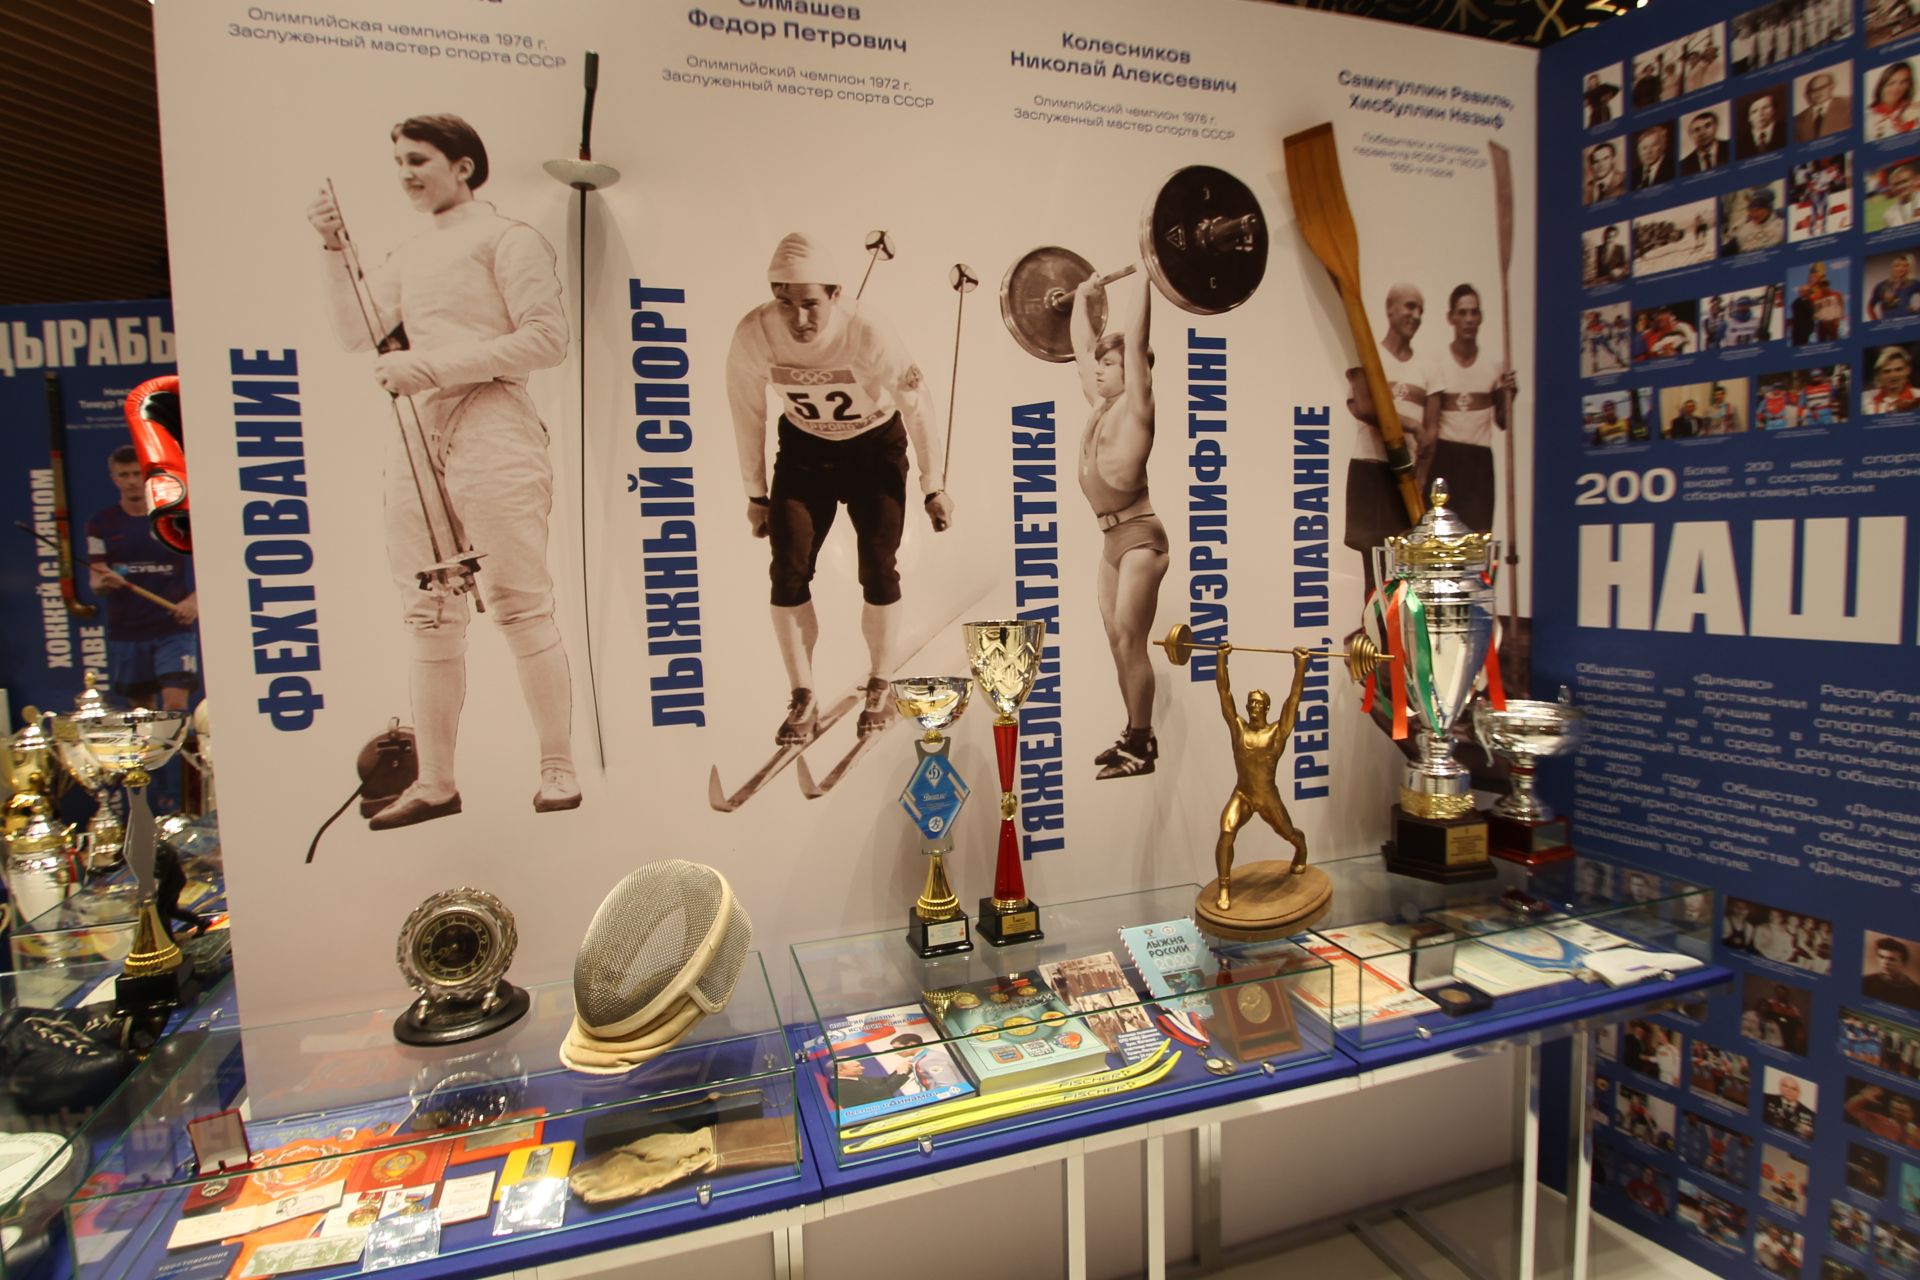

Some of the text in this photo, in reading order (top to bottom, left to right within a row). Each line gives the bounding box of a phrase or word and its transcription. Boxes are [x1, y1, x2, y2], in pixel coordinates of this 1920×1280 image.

[228, 23, 566, 69] Заслуженный мастер спорта СССР
[248, 7, 382, 33] Олимпийская
[388, 23, 489, 44] чемпионка
[496, 33, 532, 49] 1976
[688, 8, 908, 52] Федор Петрович
[1062, 32, 1191, 64] Колесников
[662, 69, 934, 109] Заслуженный мастер спорта СССР
[687, 55, 796, 77] Олимпийский
[800, 71, 865, 86] чемпион
[869, 76, 900, 90] 1972
[1010, 50, 1237, 93] Николай Алексеевич
[1014, 107, 1236, 141] Заслуженный мастер спорта СССР
[1034, 94, 1122, 115] Олимпийский
[1125, 107, 1179, 121] чемпион
[786, 390, 862, 421] 52
[1745, 461, 1774, 472] 200
[1768, 472, 1839, 484] составы
[1852, 467, 1920, 480] национ
[627, 278, 706, 728] ЛЫЖНЫЙ СПОРТ
[1187, 328, 1228, 682] ПАУЭРЛИФТИНГ
[1574, 467, 1677, 506] 200
[1011, 400, 1060, 635] АТЛЕТИКА
[1293, 405, 1330, 628] ПЛАВАНИЕ
[229, 348, 325, 732] ФЕХТОВАНИЕ
[1577, 515, 1920, 646] НАШ
[36, 582, 73, 669] ХОККЕЙ
[1722, 781, 1818, 807] Общество
[1836, 769, 1920, 791] общест
[1146, 936, 1185, 950] ЛЫЖНЯ
[1148, 944, 1190, 958] РОССИИ
